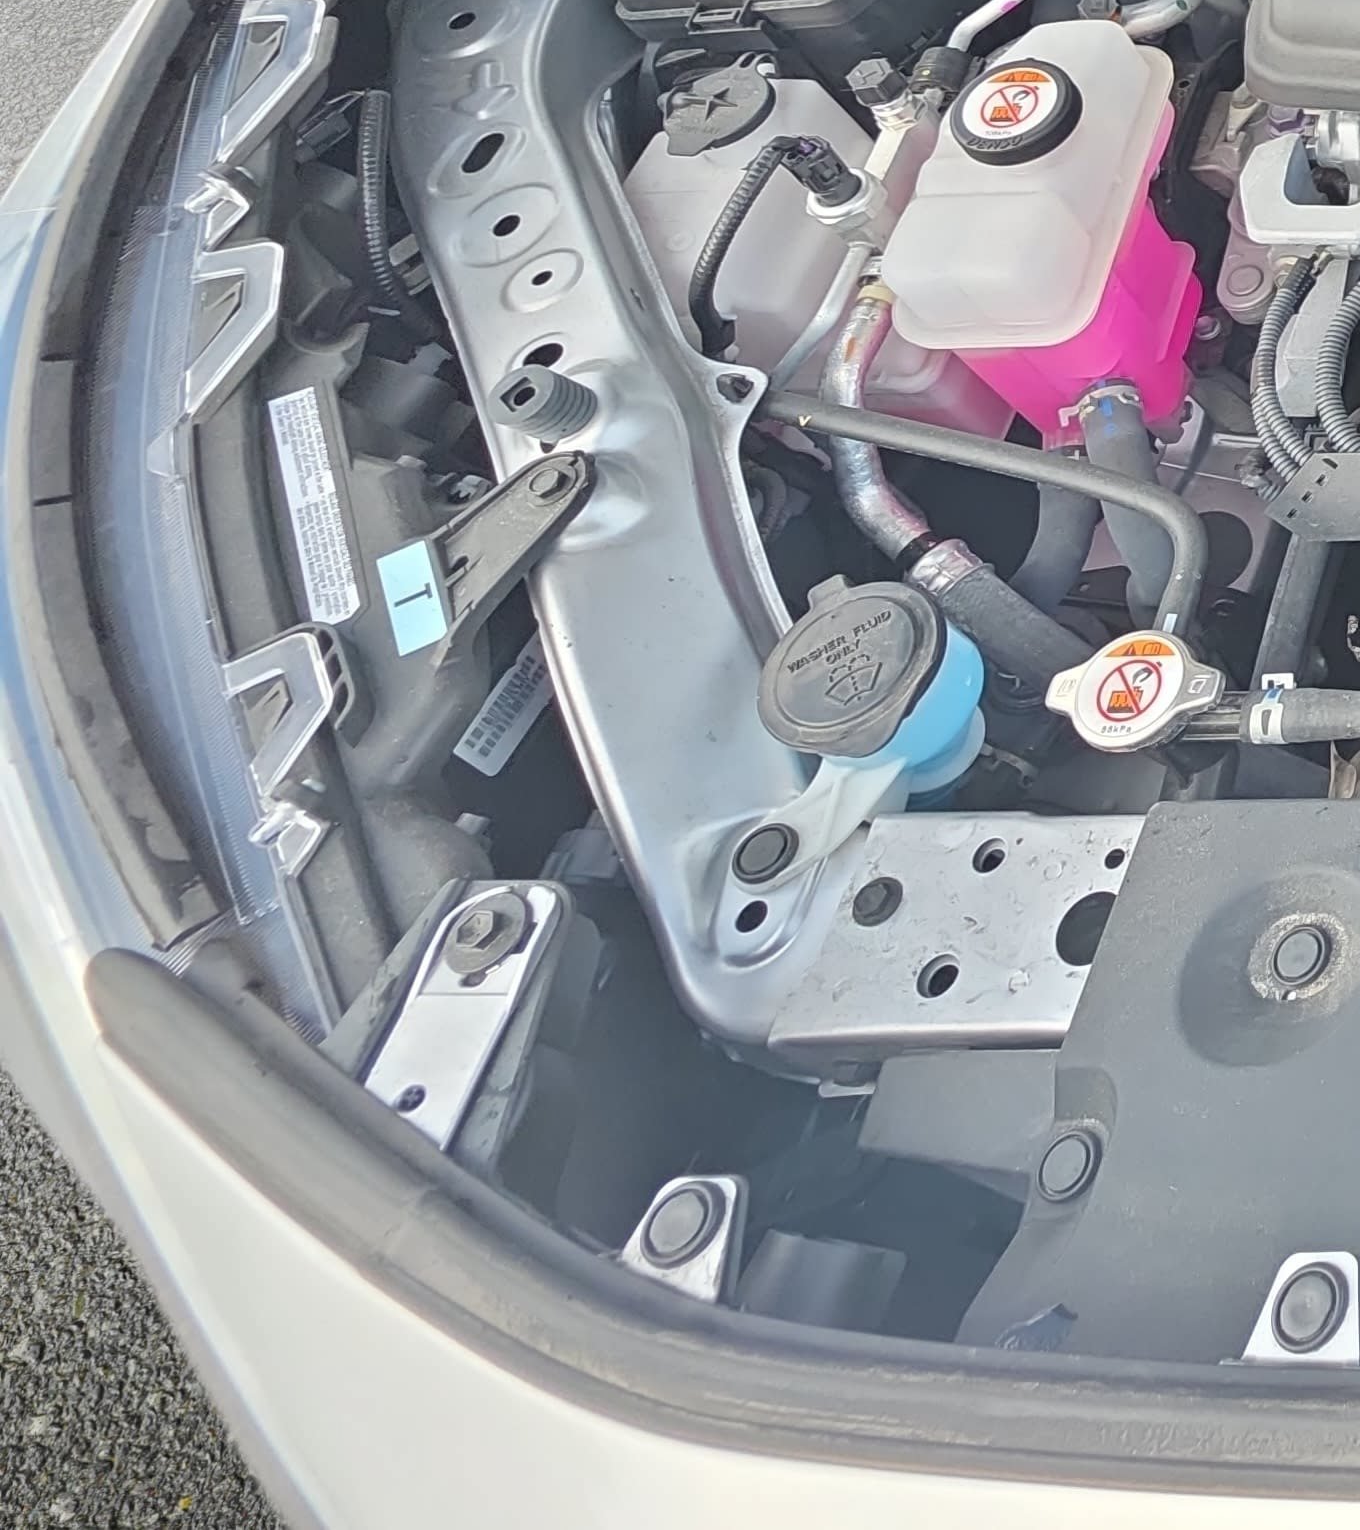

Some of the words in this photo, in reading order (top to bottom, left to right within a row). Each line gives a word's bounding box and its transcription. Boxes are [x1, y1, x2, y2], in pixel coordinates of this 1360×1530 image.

[966, 134, 1024, 150] DENSO
[786, 634, 847, 673] WASHER
[853, 610, 892, 638] FLUID
[825, 638, 861, 665] ONLY
